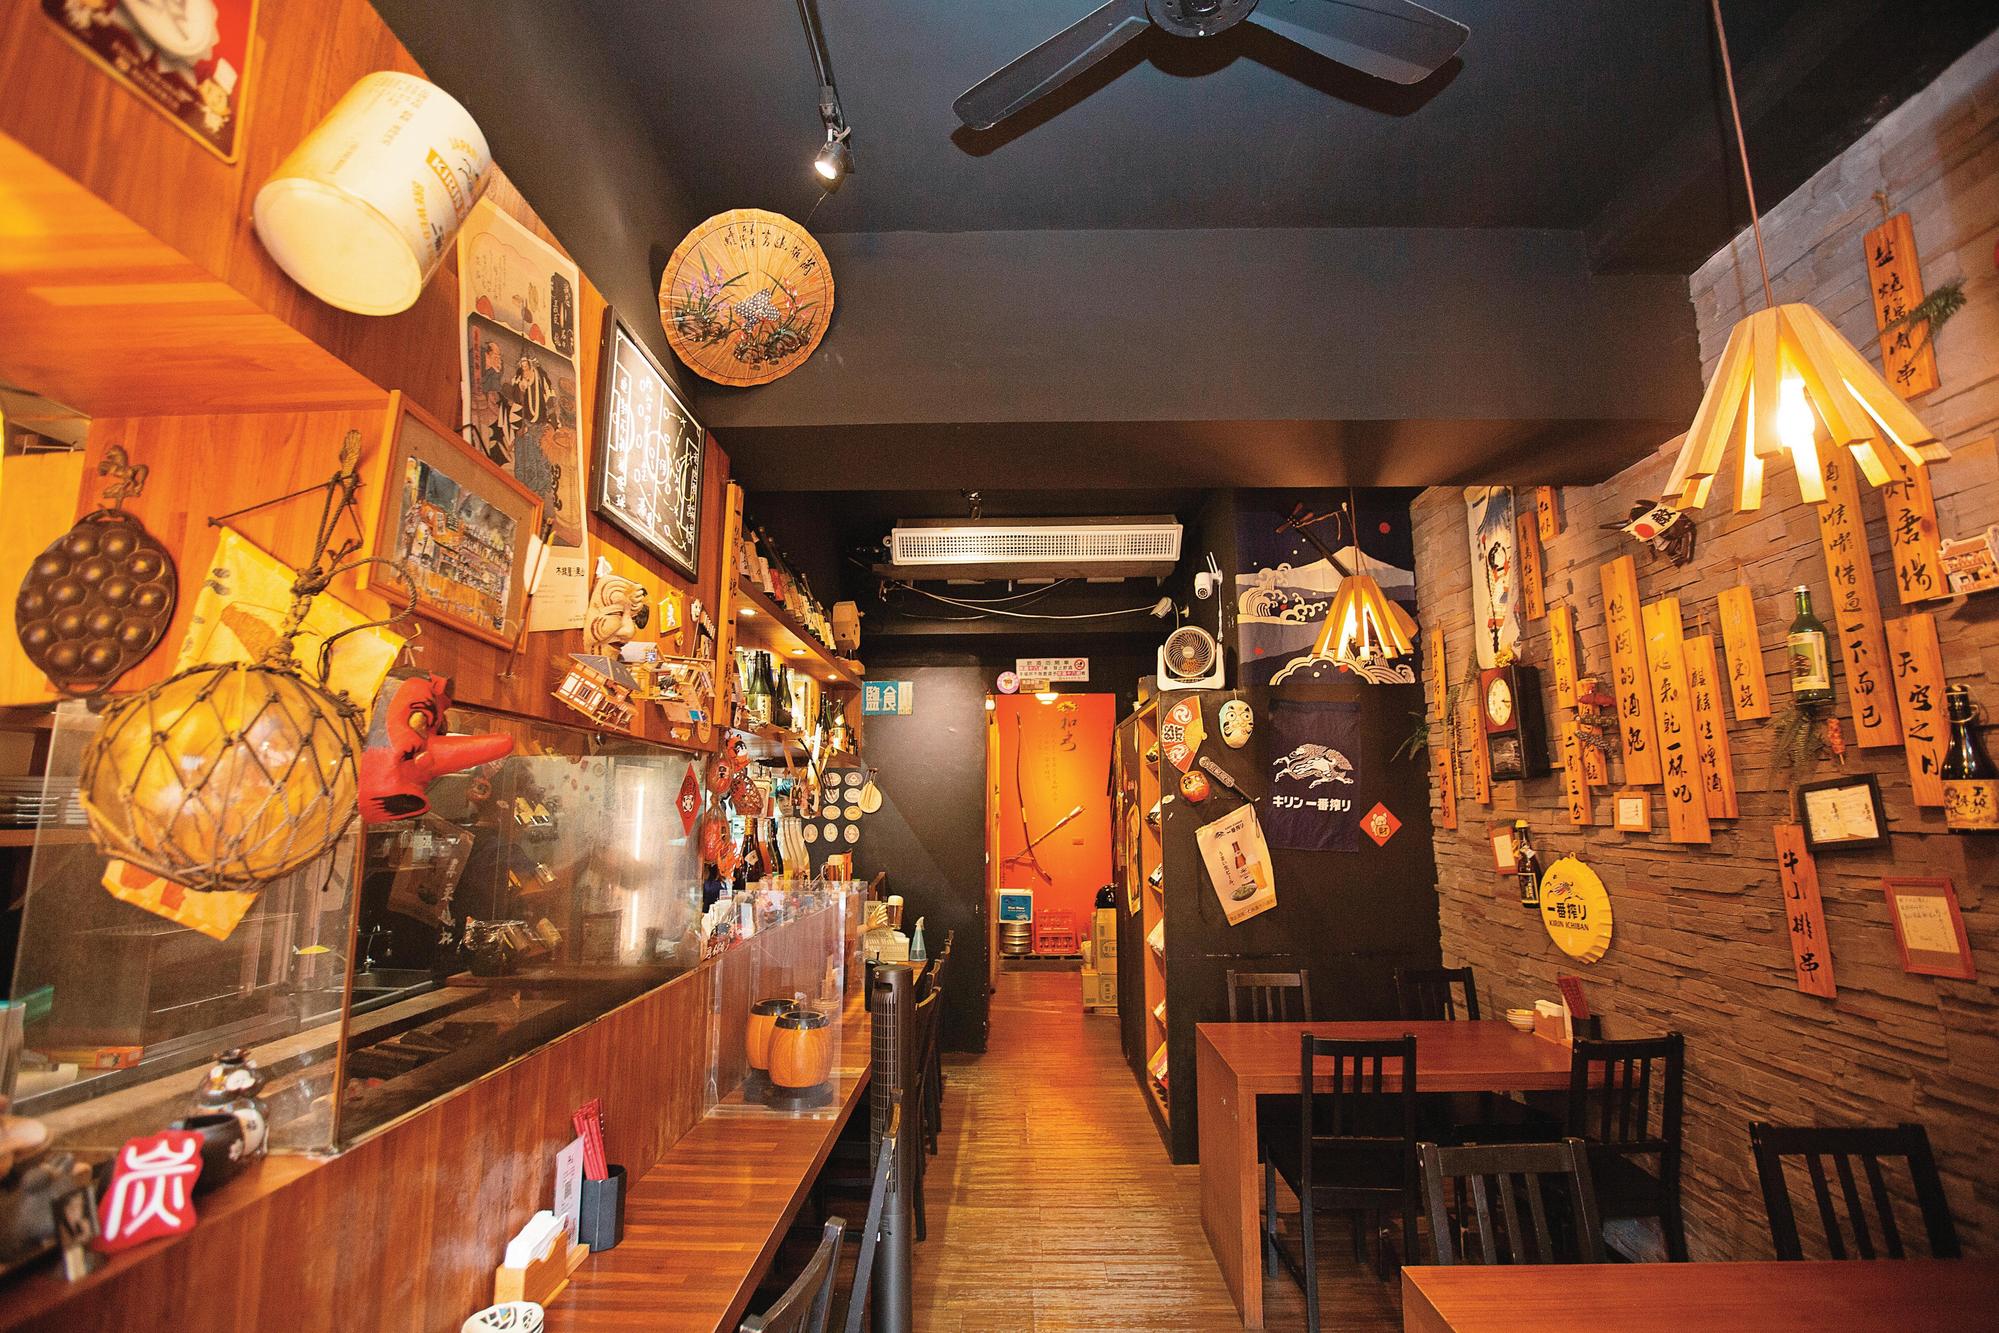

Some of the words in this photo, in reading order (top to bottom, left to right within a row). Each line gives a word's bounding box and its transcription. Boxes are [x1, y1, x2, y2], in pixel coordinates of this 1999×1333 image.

[1547, 902, 1587, 921] 一番搾り
[105, 1137, 198, 1242] 炭
